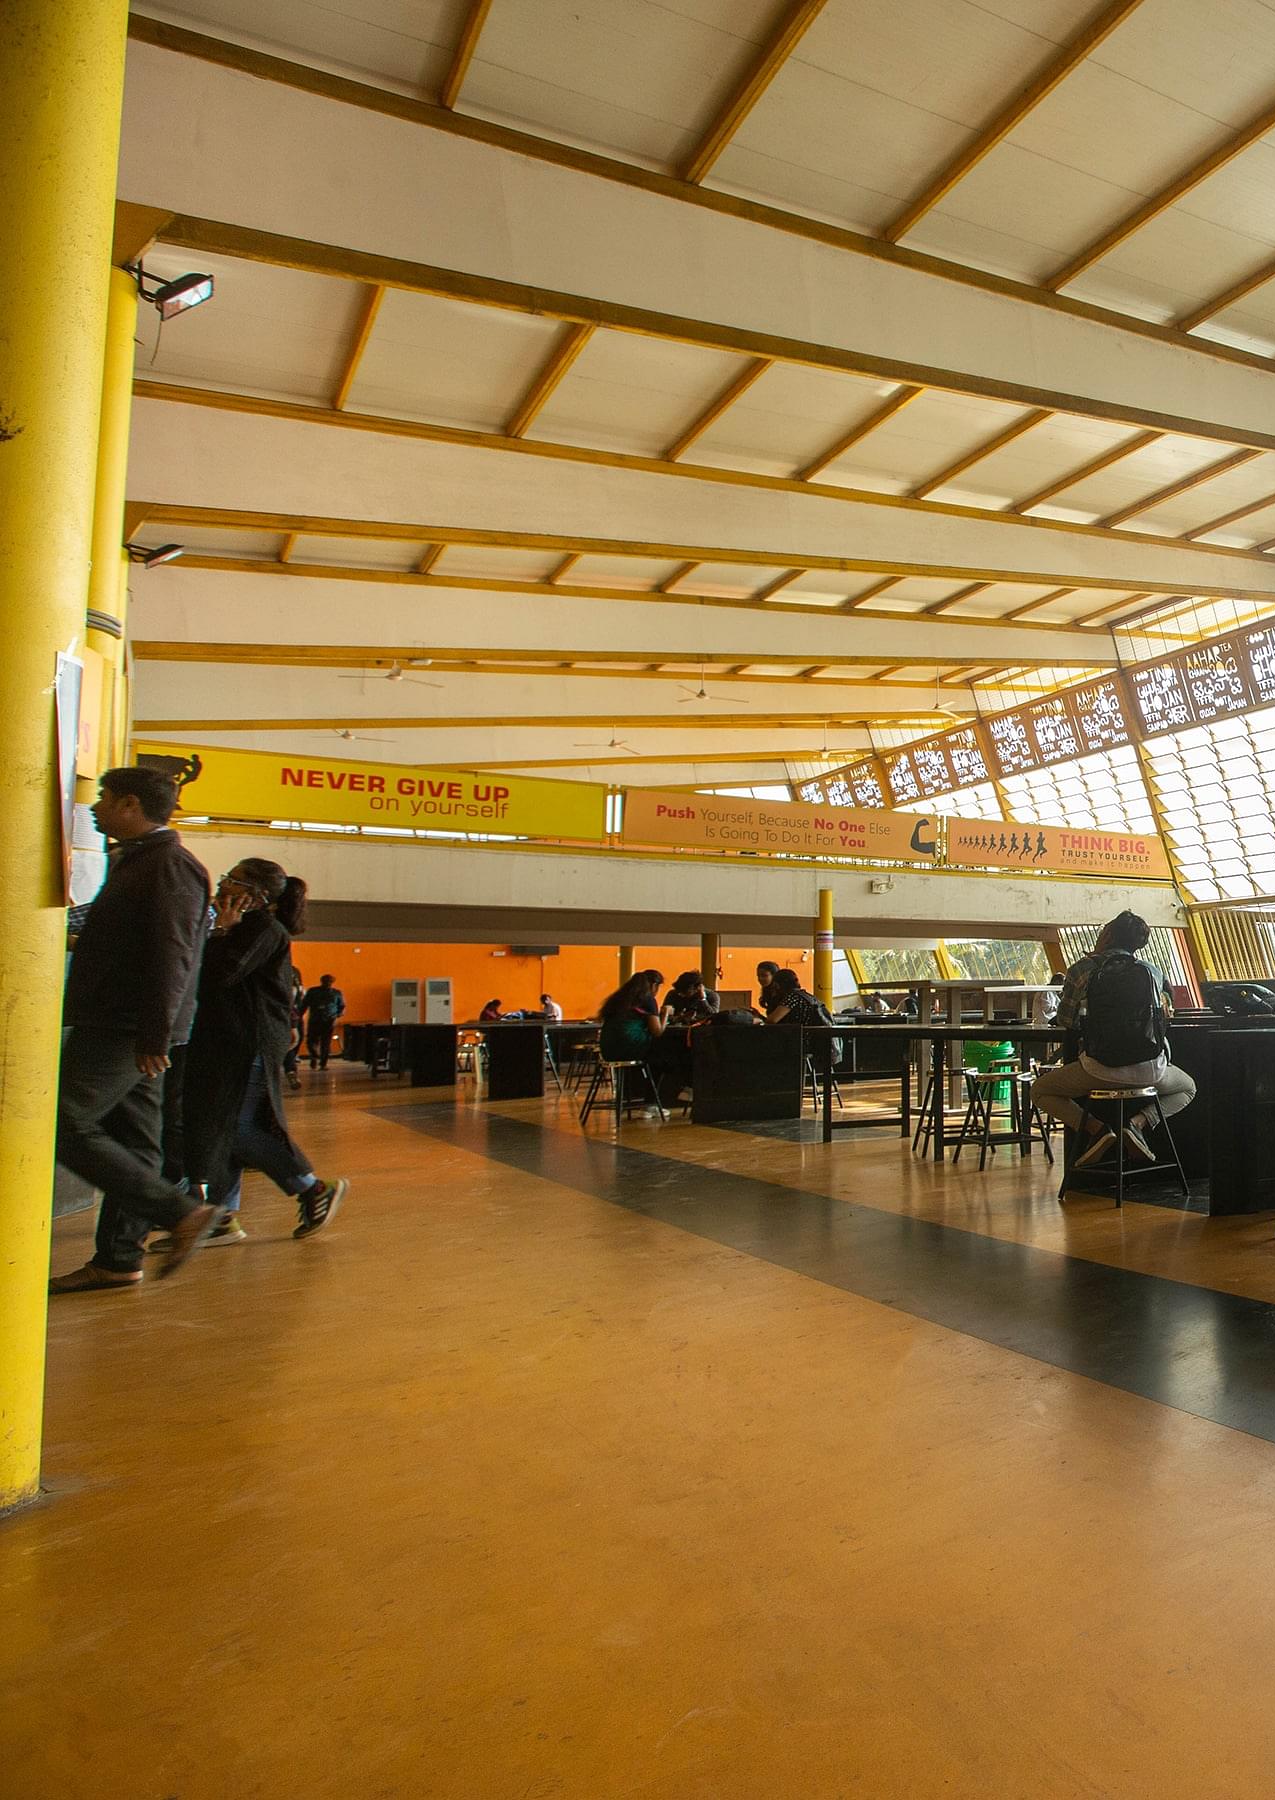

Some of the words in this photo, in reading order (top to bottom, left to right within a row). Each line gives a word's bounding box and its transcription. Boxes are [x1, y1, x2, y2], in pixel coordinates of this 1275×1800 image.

[1244, 631, 1263, 645] FOOD
[281, 767, 385, 793] NEVER
[397, 778, 463, 799] GIVE
[473, 784, 510, 802] UP
[369, 796, 400, 811] on
[410, 800, 510, 819] yourself
[656, 805, 695, 820] Push
[759, 813, 810, 829] Because
[813, 818, 834, 831] No
[839, 820, 866, 833] One
[869, 822, 891, 836] Else
[705, 826, 716, 838] Is
[720, 827, 759, 843] Going
[764, 830, 778, 842] To
[782, 831, 801, 844] Do
[804, 832, 812, 845] It
[816, 834, 837, 846] For
[1059, 833, 1114, 852] THINK
[1118, 839, 1151, 855] BIG.
[1060, 857, 1077, 865] and
[1080, 858, 1104, 867] make
[1118, 861, 1151, 871] happen
[1061, 849, 1095, 859] TRUST
[1098, 852, 1151, 863] YOURSELF
